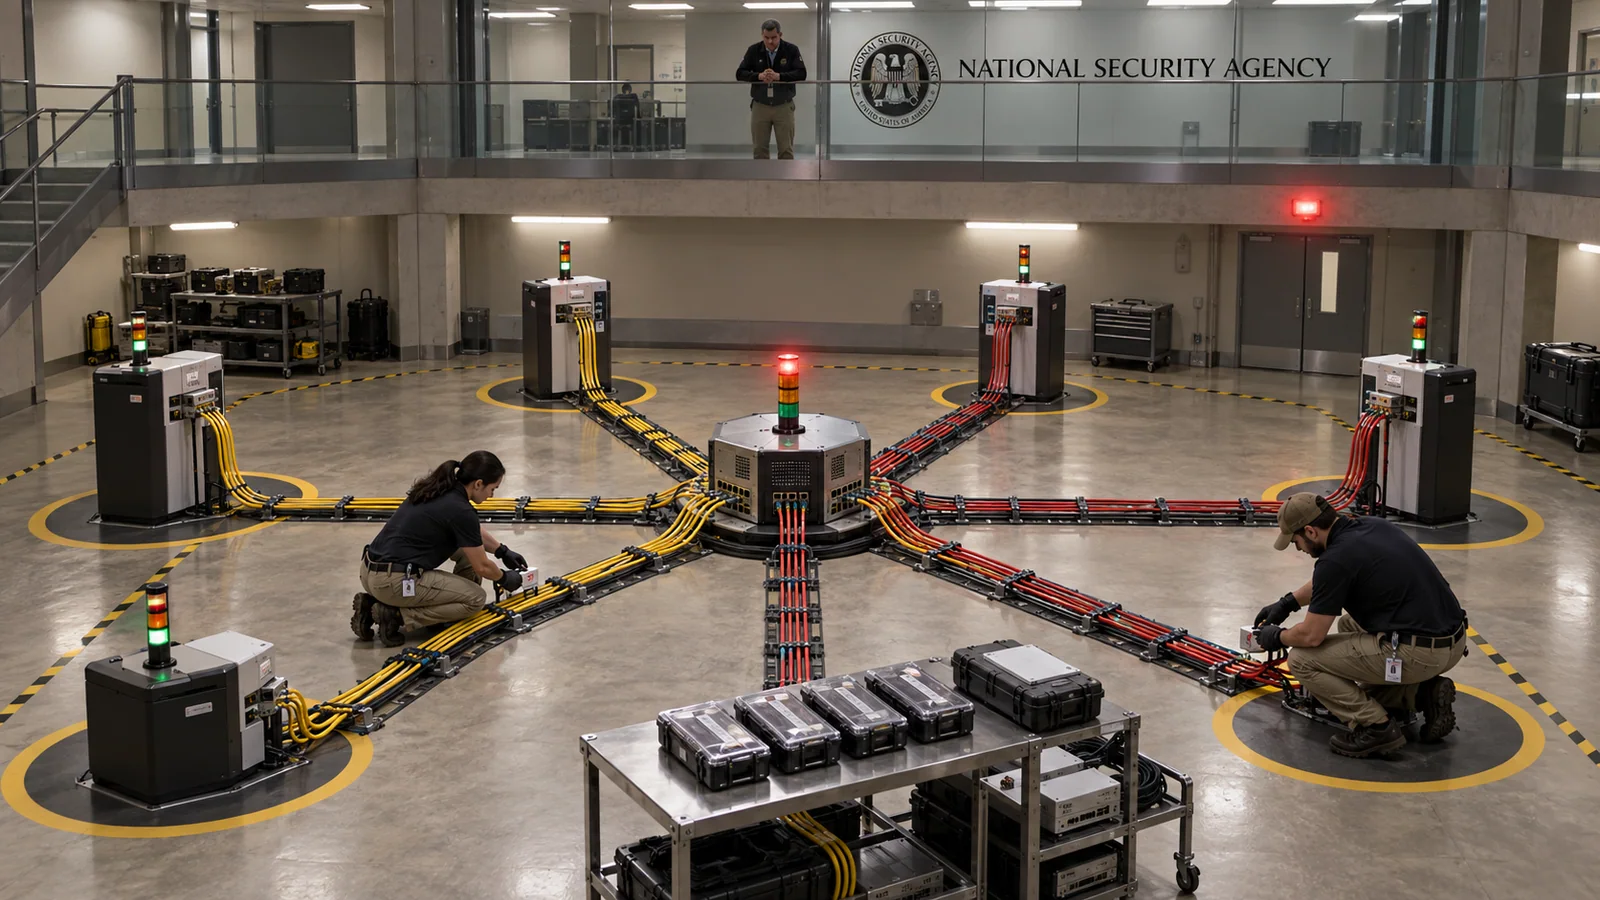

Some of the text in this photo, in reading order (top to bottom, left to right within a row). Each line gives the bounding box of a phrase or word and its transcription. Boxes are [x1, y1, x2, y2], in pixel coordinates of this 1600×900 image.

[878, 35, 921, 49] SECURITY
[959, 57, 1332, 78] NATIONAL SECURITY AGENCY
